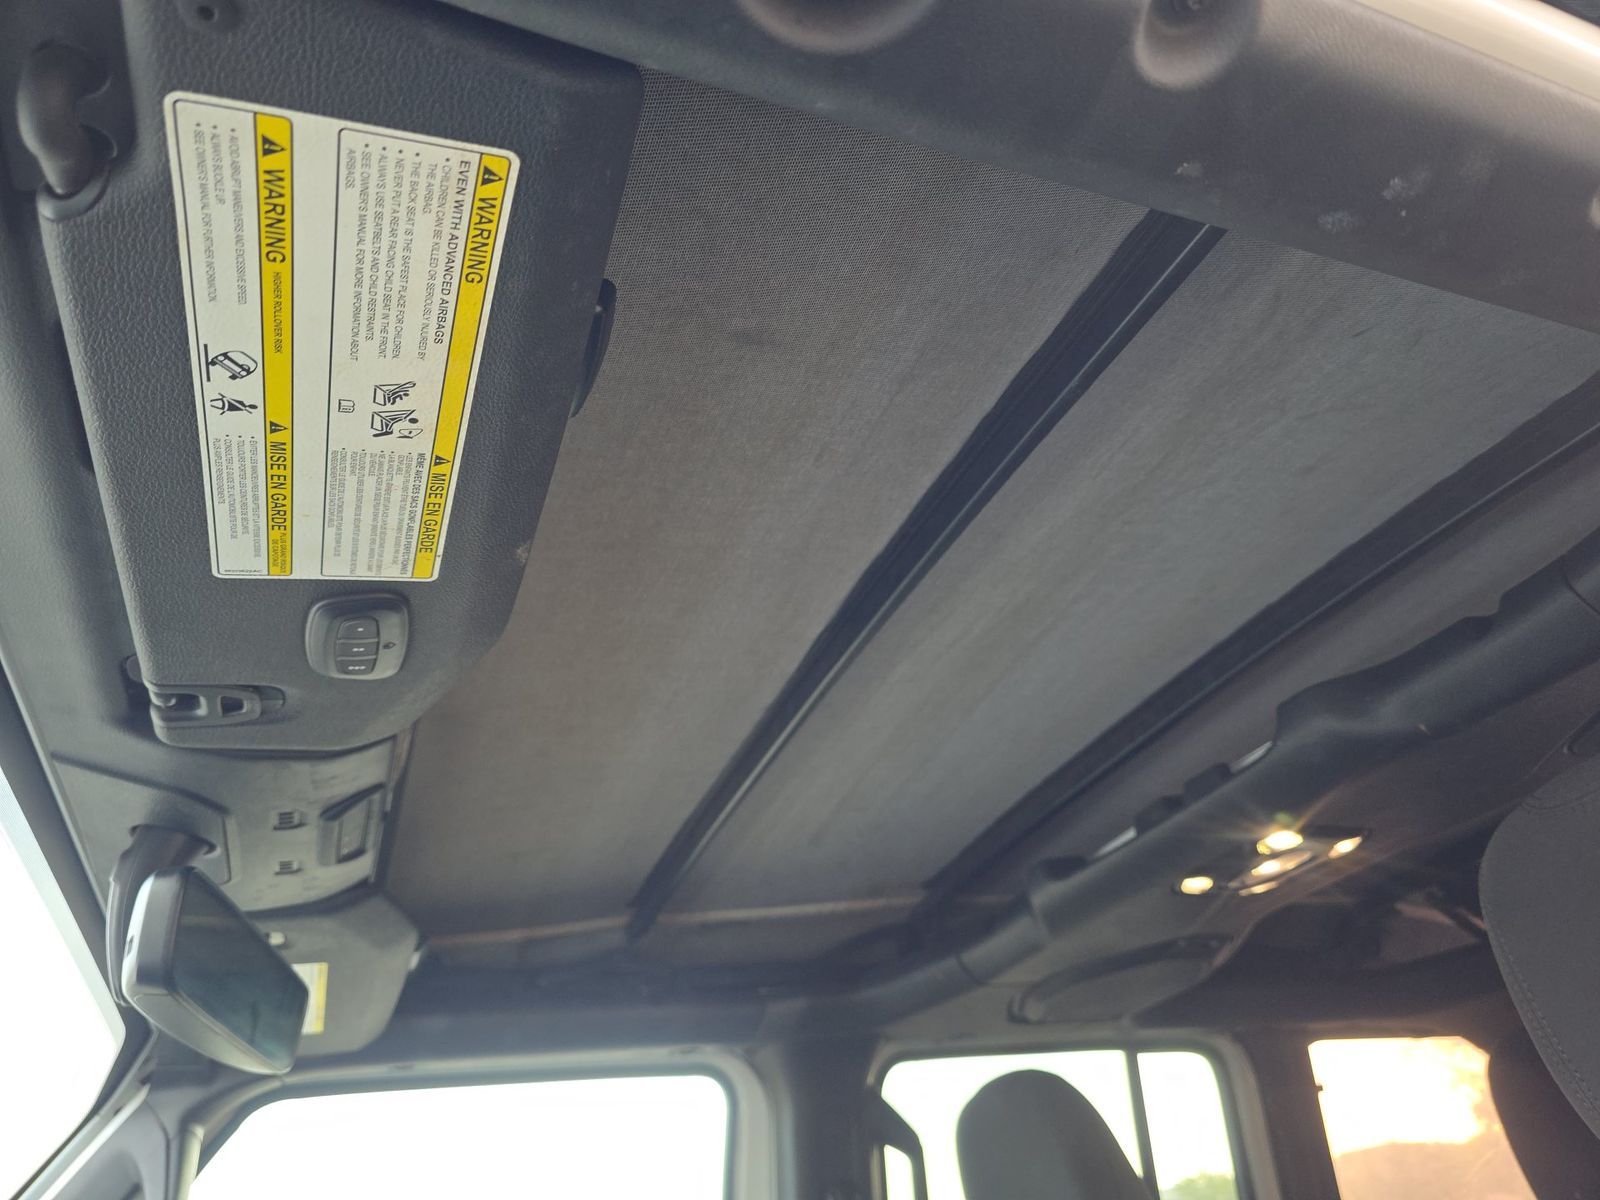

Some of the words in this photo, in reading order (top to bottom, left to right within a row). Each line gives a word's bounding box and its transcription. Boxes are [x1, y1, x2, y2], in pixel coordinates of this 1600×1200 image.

[360, 150, 371, 171] SEE
[376, 153, 388, 190] ALWAYS
[409, 160, 421, 178] THE
[426, 162, 437, 180] THE
[392, 157, 405, 189] NEVER
[454, 159, 471, 195] EVEN
[390, 189, 402, 207] PUT
[407, 179, 419, 205] BACK
[436, 164, 451, 209] CHILDREN
[374, 191, 385, 209] USE
[390, 207, 400, 215] A
[262, 166, 285, 264] WARNING
[405, 205, 416, 226] SEAT
[434, 209, 445, 228] CAN
[449, 198, 465, 230] WITH
[356, 213, 367, 247] MANUAL
[371, 210, 383, 256] SEATBELTS
[388, 215, 399, 238] REAR
[404, 228, 413, 236] IS
[432, 229, 442, 240] BE
[402, 237, 412, 253] THE
[463, 194, 497, 284] WARNING
[355, 248, 364, 266] FOR
[370, 256, 379, 273] AND
[385, 239, 397, 269] FACING
[428, 241, 440, 268] KILLED
[440, 232, 459, 295] ADVANCED
[353, 266, 363, 289] MORE
[399, 254, 410, 283] SAFEST
[427, 269, 437, 280] OR
[272, 271, 282, 299] HIGHER
[368, 274, 378, 296] CHILD
[383, 269, 394, 292] CHILD
[381, 293, 392, 311] SEAT
[396, 285, 407, 309] PLACE
[422, 282, 435, 321] SERIOUSLY
[273, 300, 282, 337] ROLLOVER
[350, 290, 362, 338] INFORMATION
[381, 312, 390, 320] IN
[395, 309, 405, 324] FOR
[433, 297, 449, 344] AIRBAGS
[379, 320, 389, 335] THE
[418, 322, 430, 350] INJURED
[273, 338, 282, 354] RISK
[349, 338, 358, 361] ABOUT
[417, 351, 426, 360] BY
[269, 440, 286, 470] MISE
[415, 452, 427, 468] MÊME
[270, 473, 286, 489] EN
[412, 469, 424, 483] AVEC
[427, 472, 446, 499] MISE
[411, 484, 422, 494] DES
[270, 493, 286, 531] GARDE
[409, 495, 420, 508] SACS
[425, 502, 441, 516] EN
[418, 518, 438, 553] GARDE
